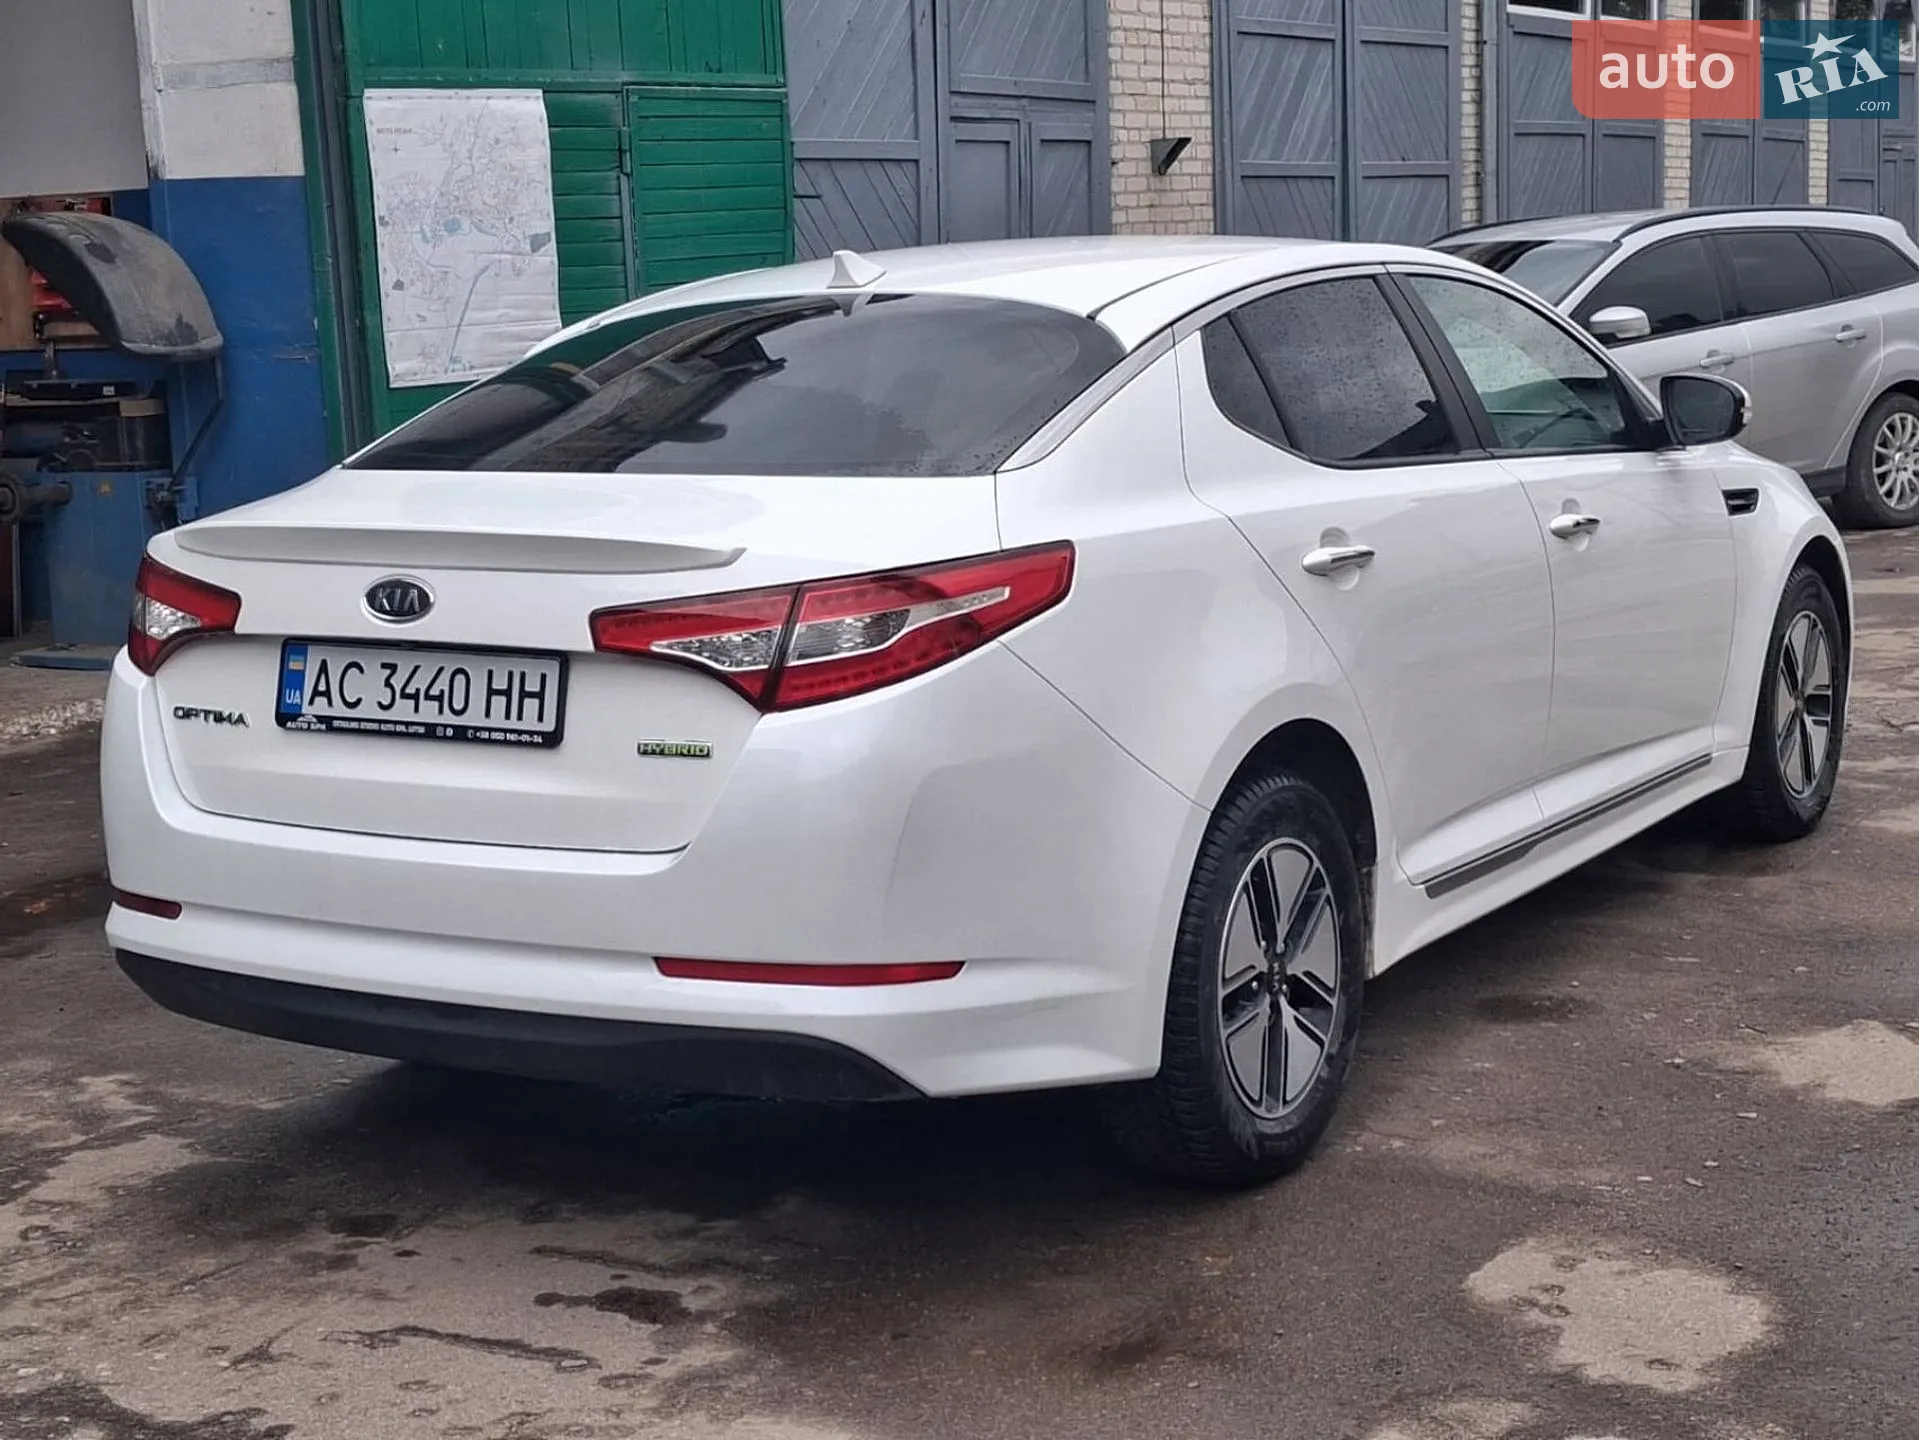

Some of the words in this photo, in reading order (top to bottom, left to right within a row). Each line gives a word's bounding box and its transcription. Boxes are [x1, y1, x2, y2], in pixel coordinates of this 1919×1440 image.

[375, 587, 420, 612] KIA
[286, 688, 301, 705] UA
[308, 658, 365, 709] AC
[376, 662, 471, 716] 3440
[484, 669, 547, 723] HH
[173, 706, 249, 728] OPTIMA
[640, 743, 708, 755] HYBRID
